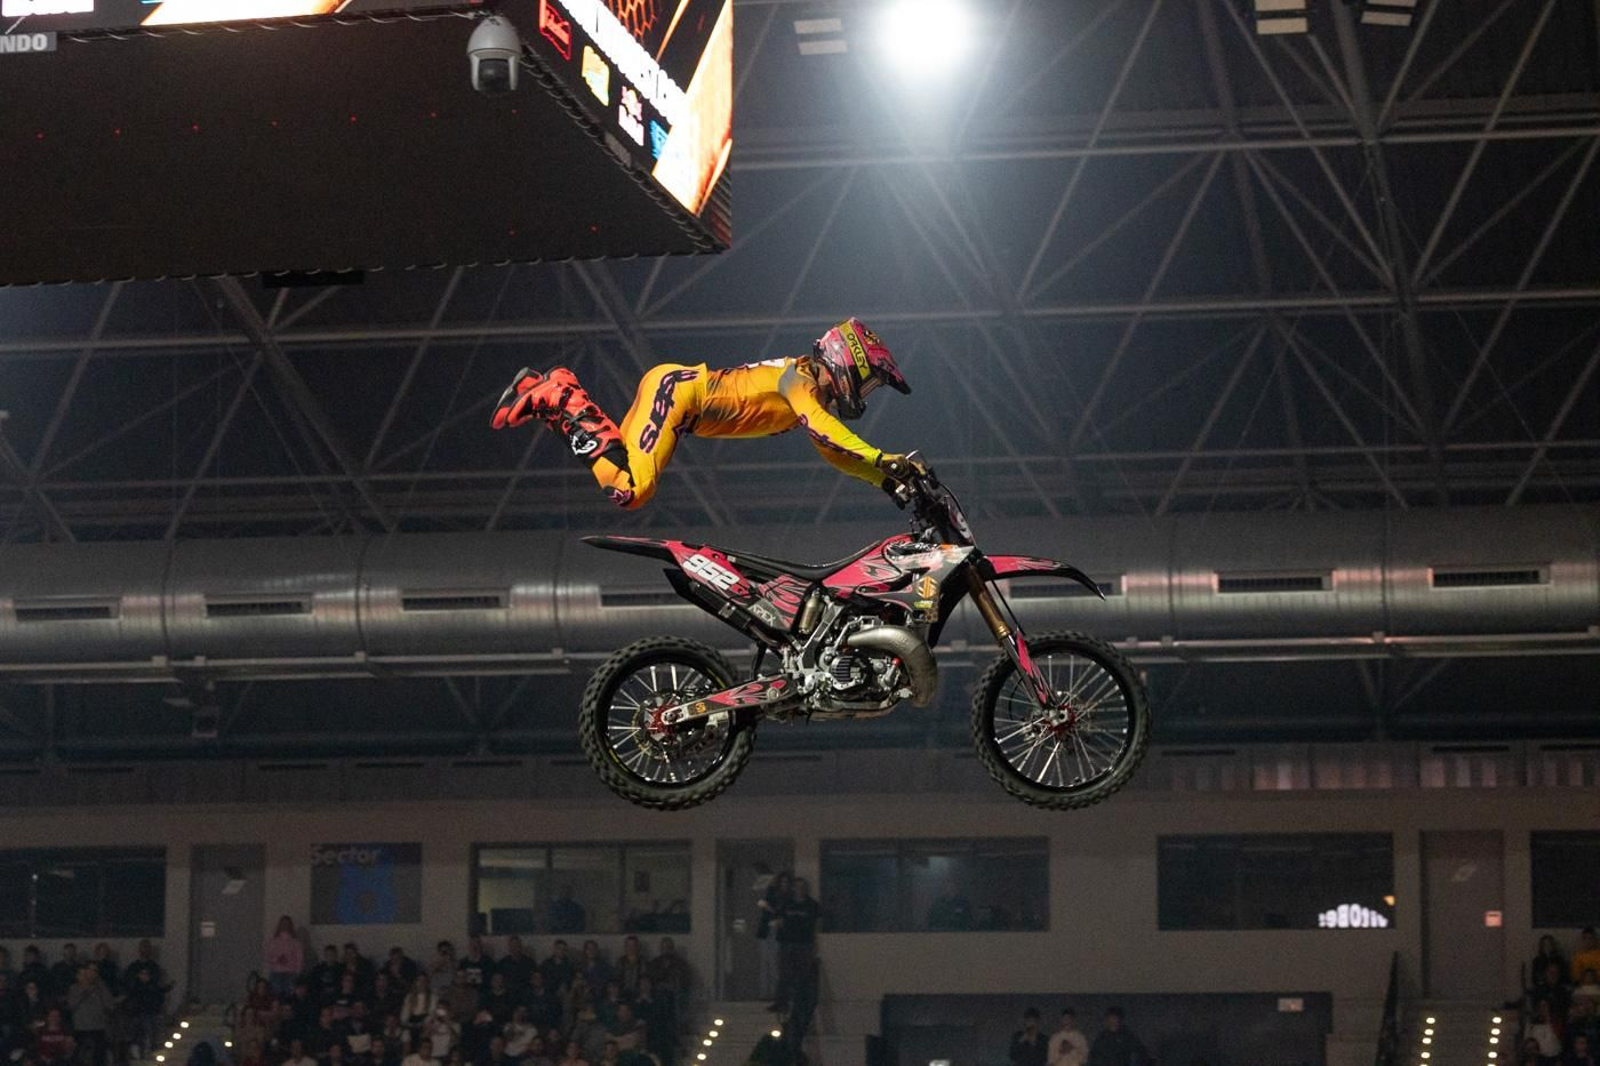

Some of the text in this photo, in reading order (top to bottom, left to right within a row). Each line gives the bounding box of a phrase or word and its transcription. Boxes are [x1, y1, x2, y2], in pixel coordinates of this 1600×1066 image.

[847, 332, 868, 369] OAKLEY
[682, 554, 740, 590] 952
[747, 604, 777, 627] APEX
